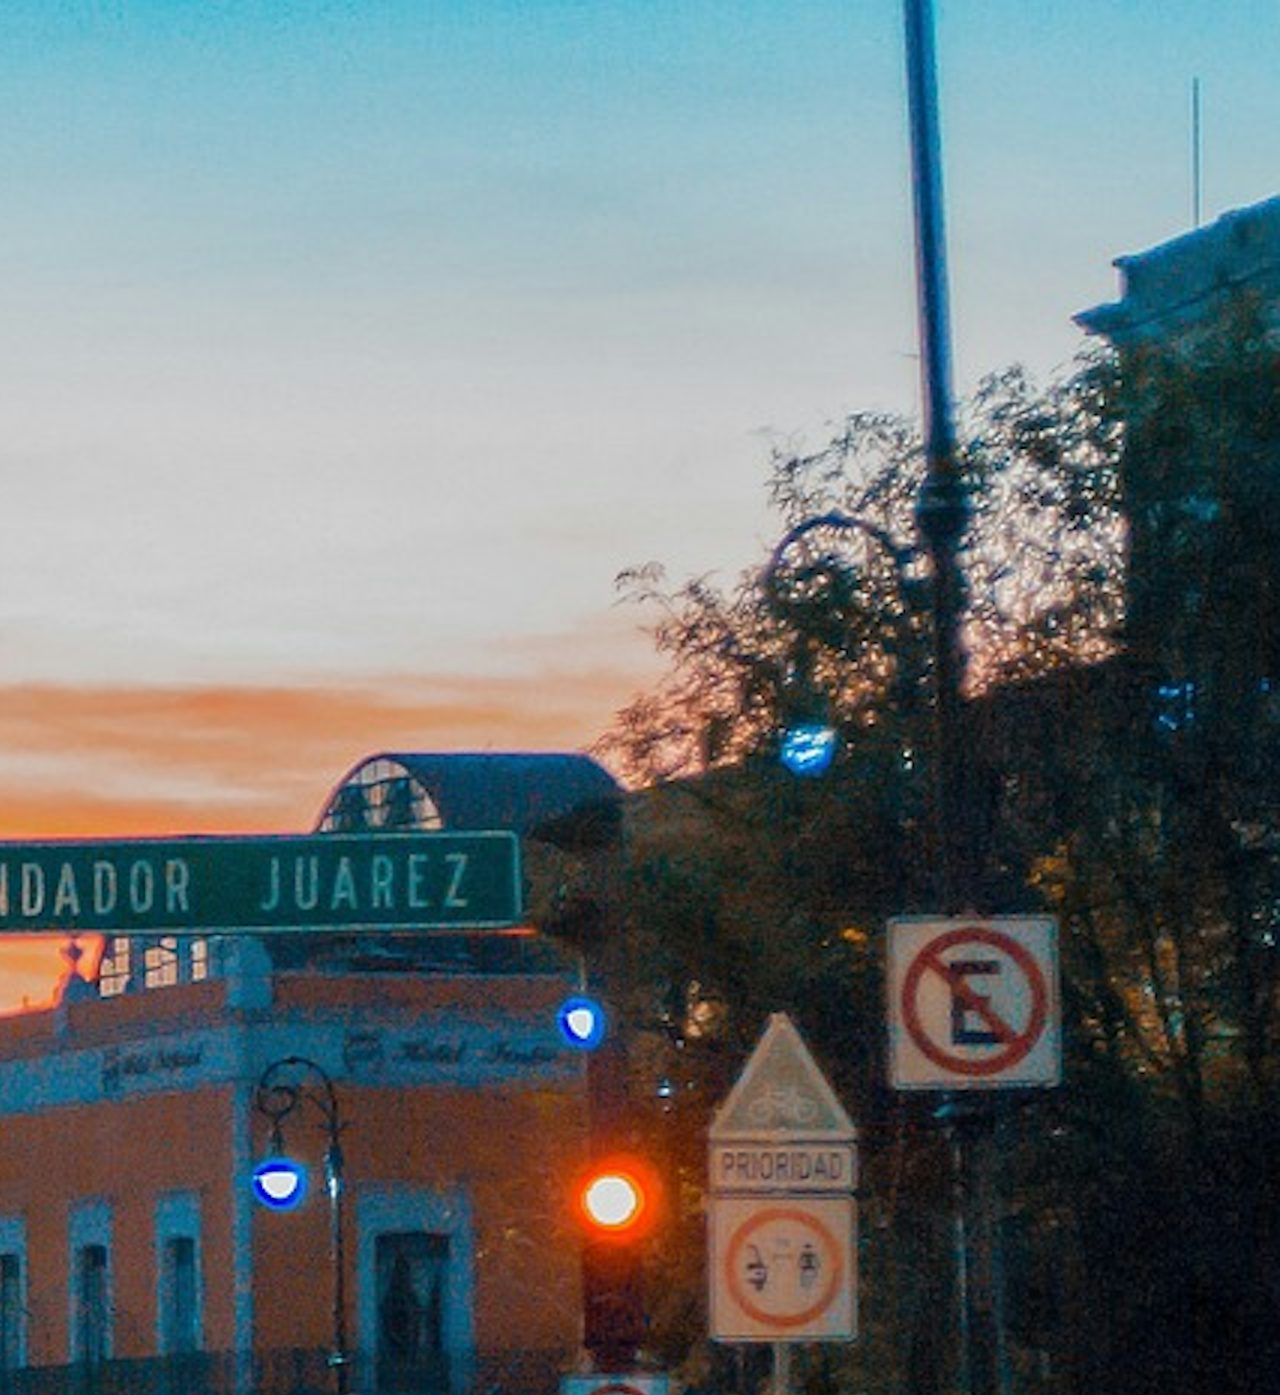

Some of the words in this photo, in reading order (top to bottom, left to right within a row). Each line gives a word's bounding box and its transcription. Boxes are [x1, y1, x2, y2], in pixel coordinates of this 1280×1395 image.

[260, 853, 468, 910] JUAREZ
[950, 961, 1007, 1045] E
[722, 1152, 842, 1180] PRIORIDAD
